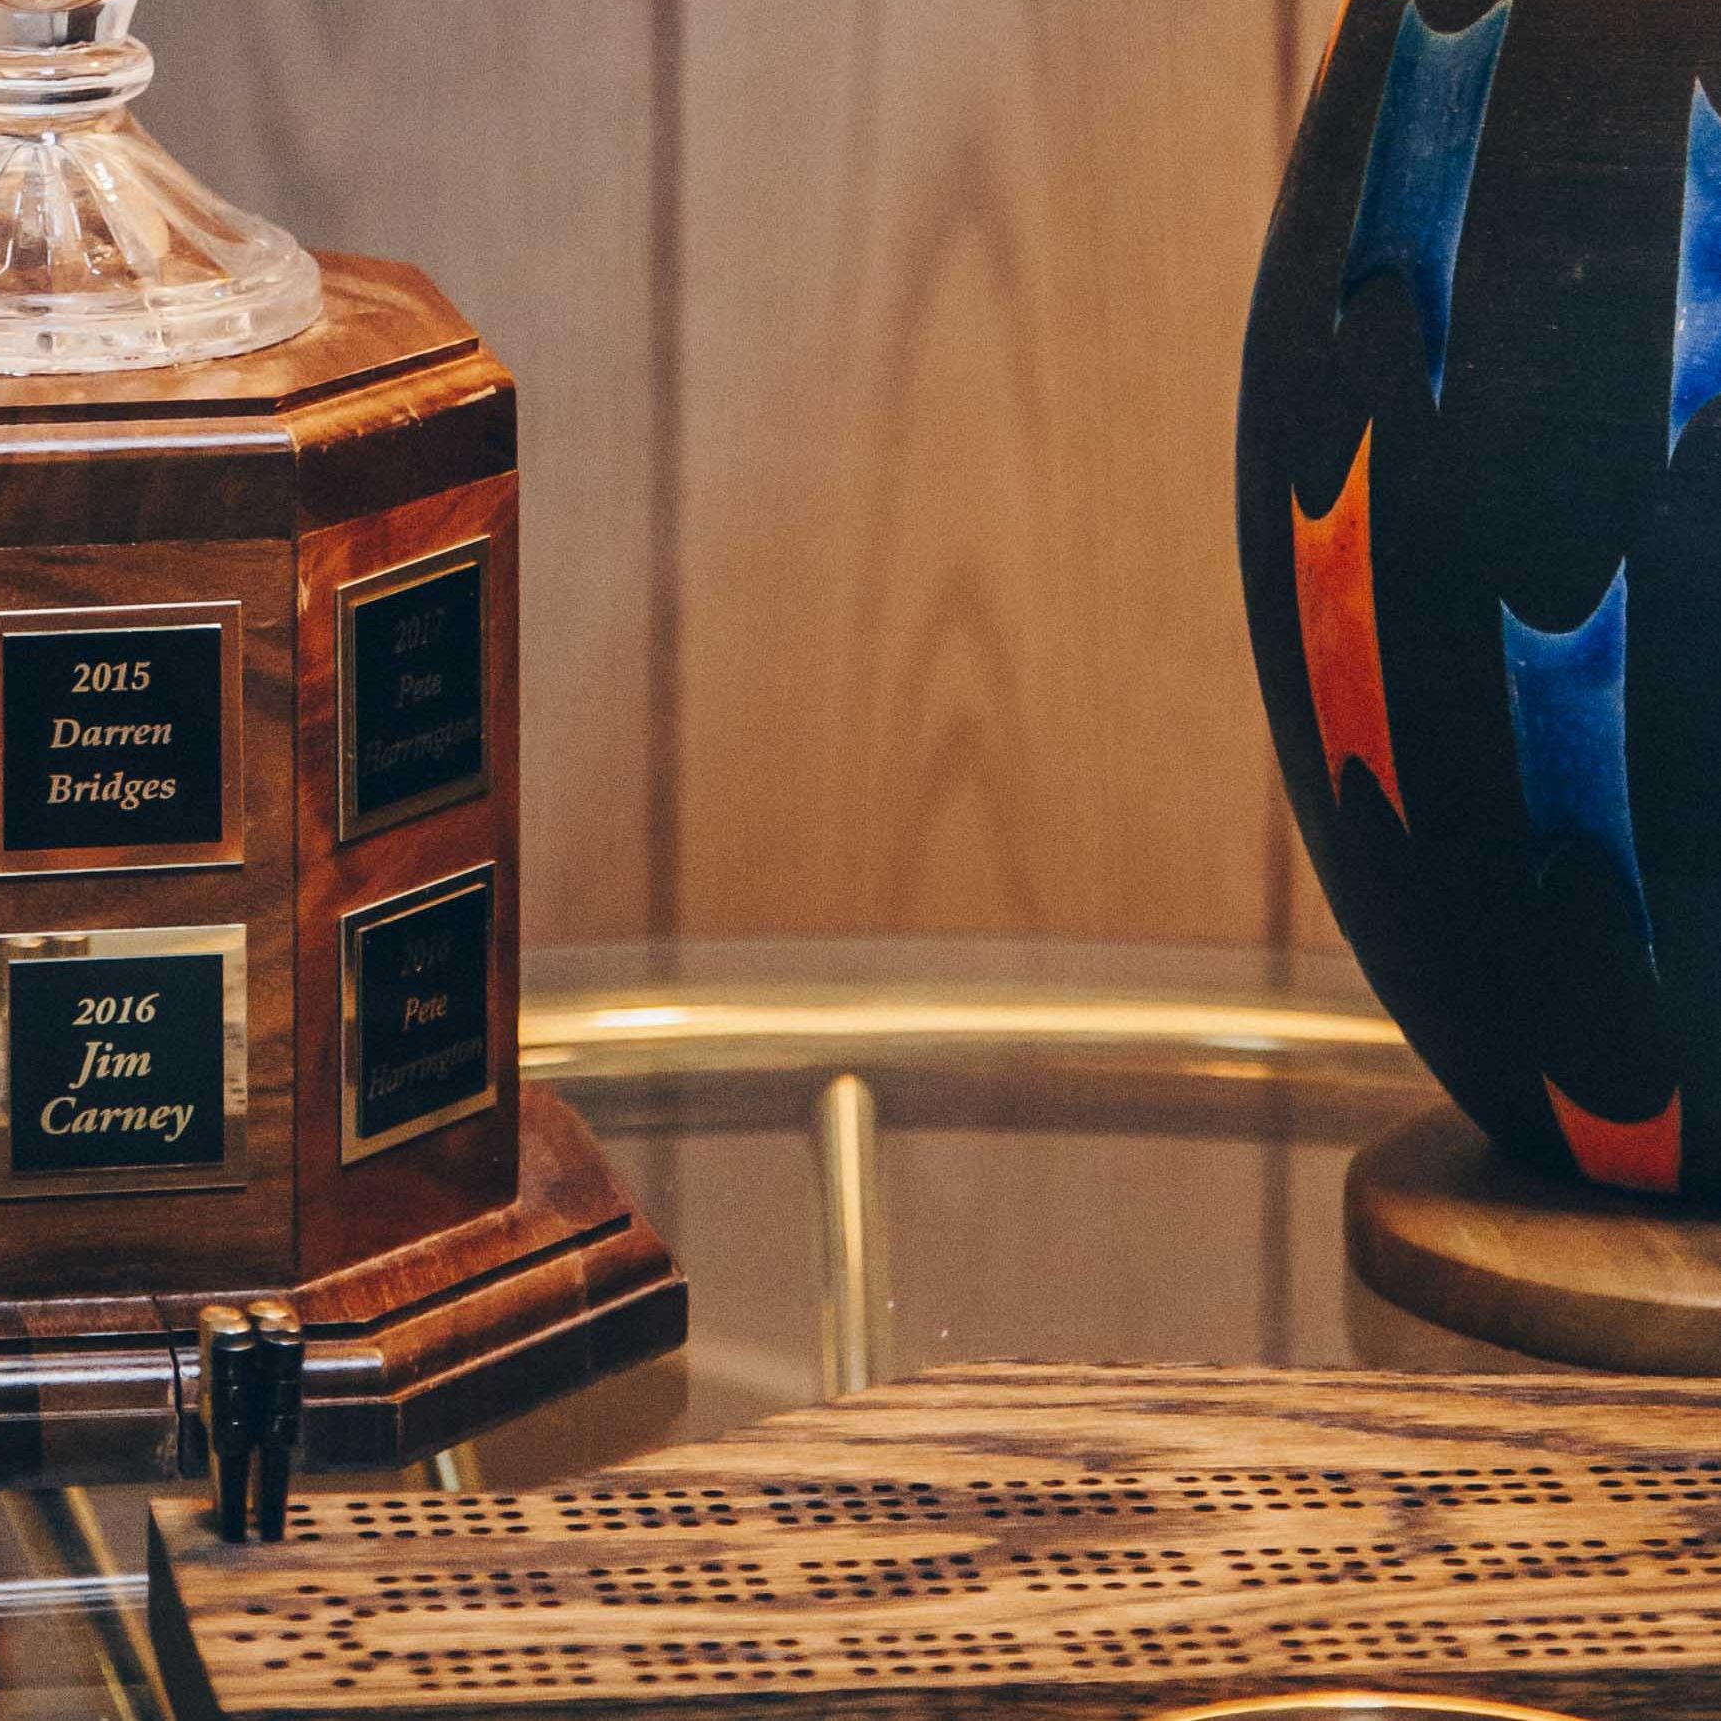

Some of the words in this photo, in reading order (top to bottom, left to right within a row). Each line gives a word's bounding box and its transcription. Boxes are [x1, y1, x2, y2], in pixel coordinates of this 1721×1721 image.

[71, 661, 152, 693] 2015
[49, 718, 173, 749] Darren
[47, 770, 177, 811] Bridges
[72, 992, 160, 1026] 2016
[400, 993, 448, 1034] Pete
[68, 1040, 152, 1090] Jim
[40, 1096, 195, 1142] Carney
